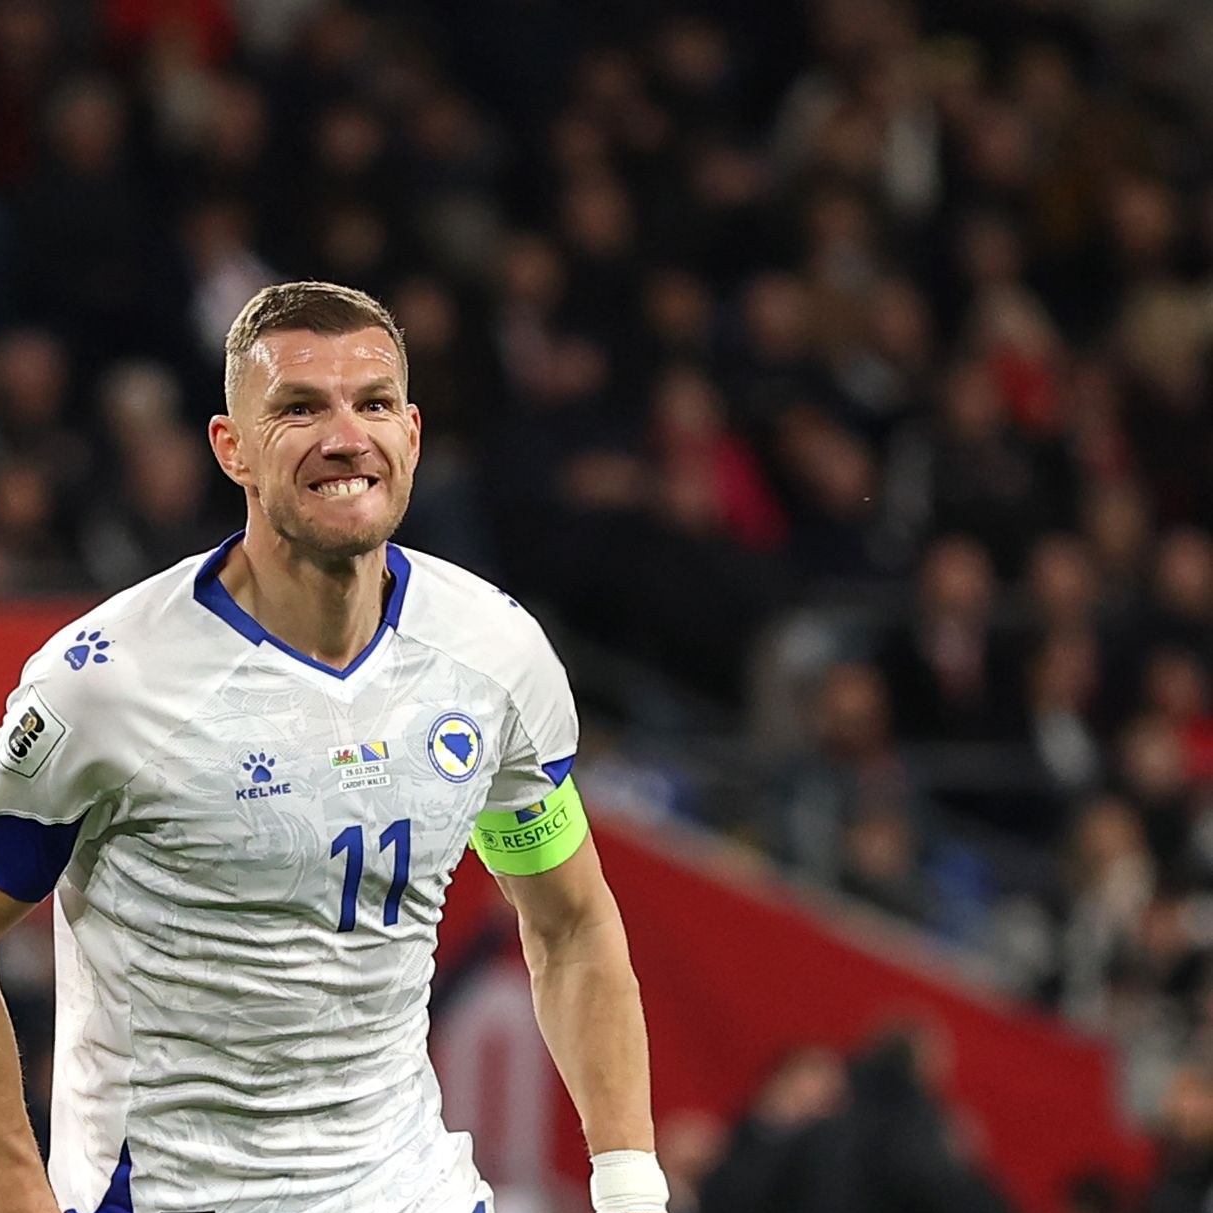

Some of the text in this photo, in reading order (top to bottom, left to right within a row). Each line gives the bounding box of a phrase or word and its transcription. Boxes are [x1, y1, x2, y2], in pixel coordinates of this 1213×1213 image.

[236, 783, 291, 800] KELME
[502, 807, 569, 849] RESPECT
[330, 818, 411, 933] 11
